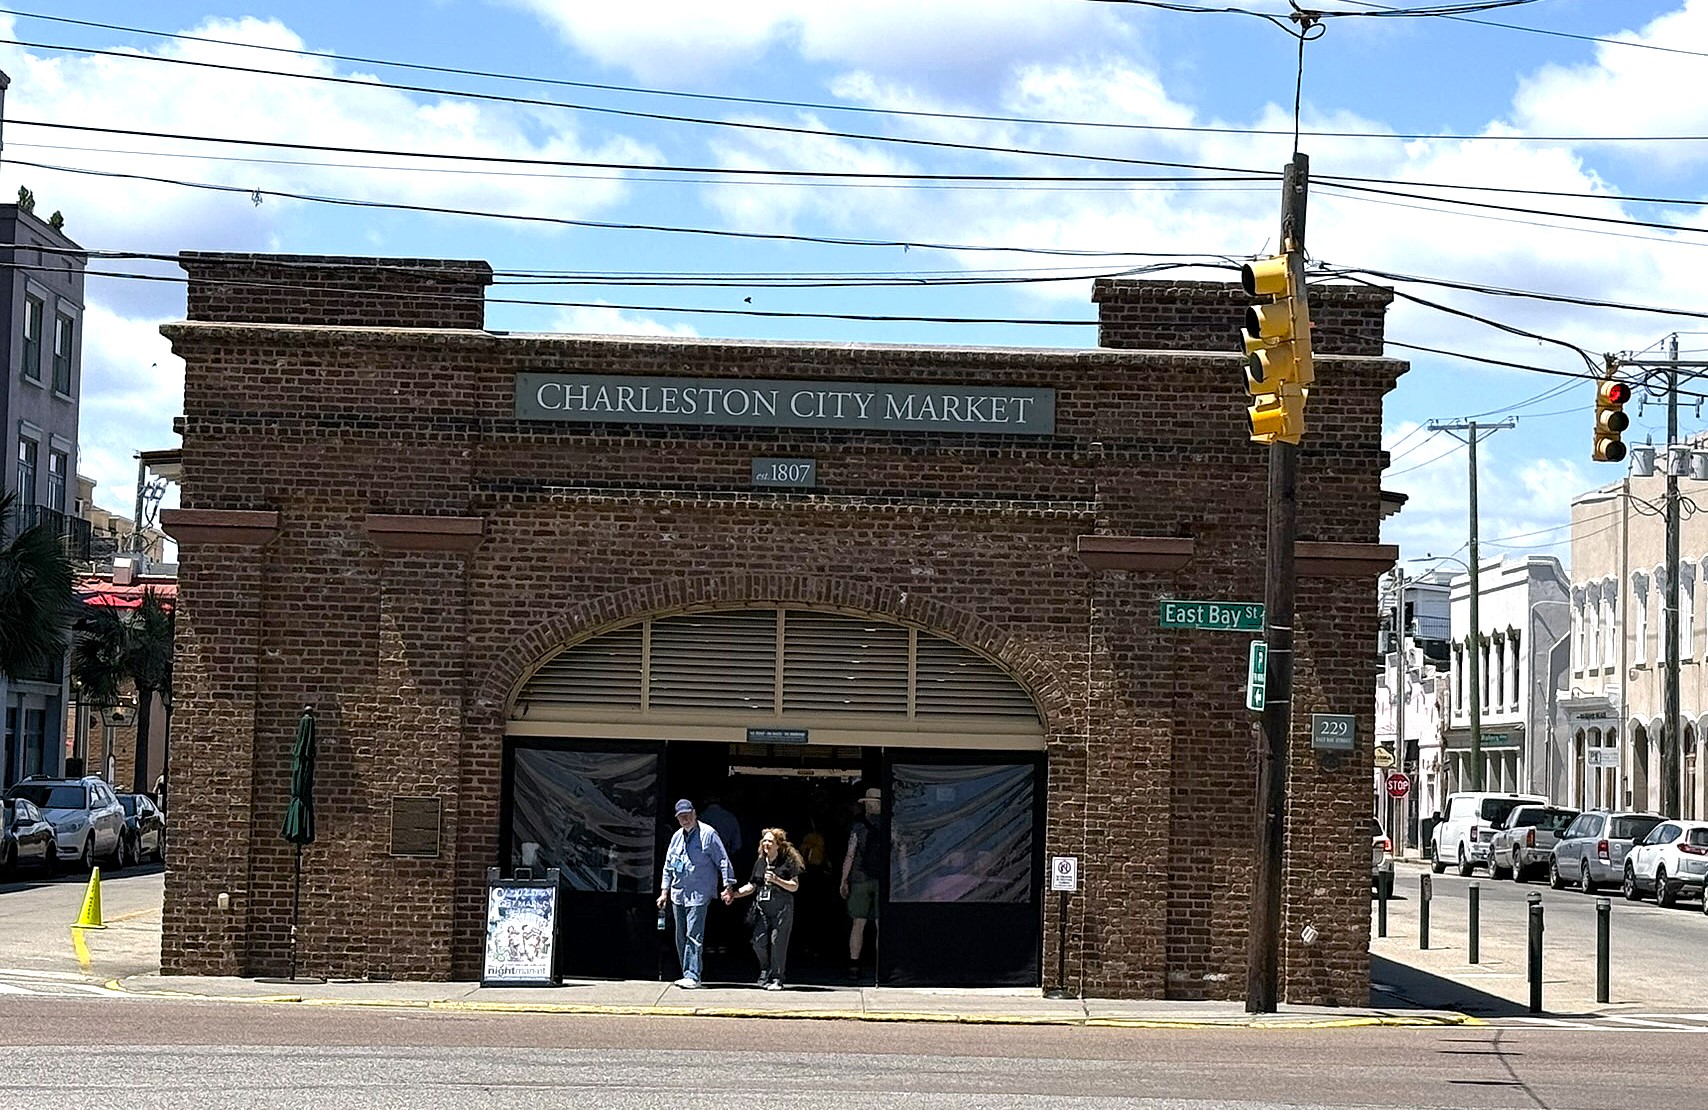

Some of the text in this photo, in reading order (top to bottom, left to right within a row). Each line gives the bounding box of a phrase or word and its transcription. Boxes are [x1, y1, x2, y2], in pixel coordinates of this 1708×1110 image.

[536, 383, 1034, 424] CHARLESTON CITY MARKET
[771, 463, 811, 483] 1807
[1165, 604, 1258, 628] East Bay St
[1320, 721, 1348, 736] 229
[1387, 780, 1409, 791] STOP
